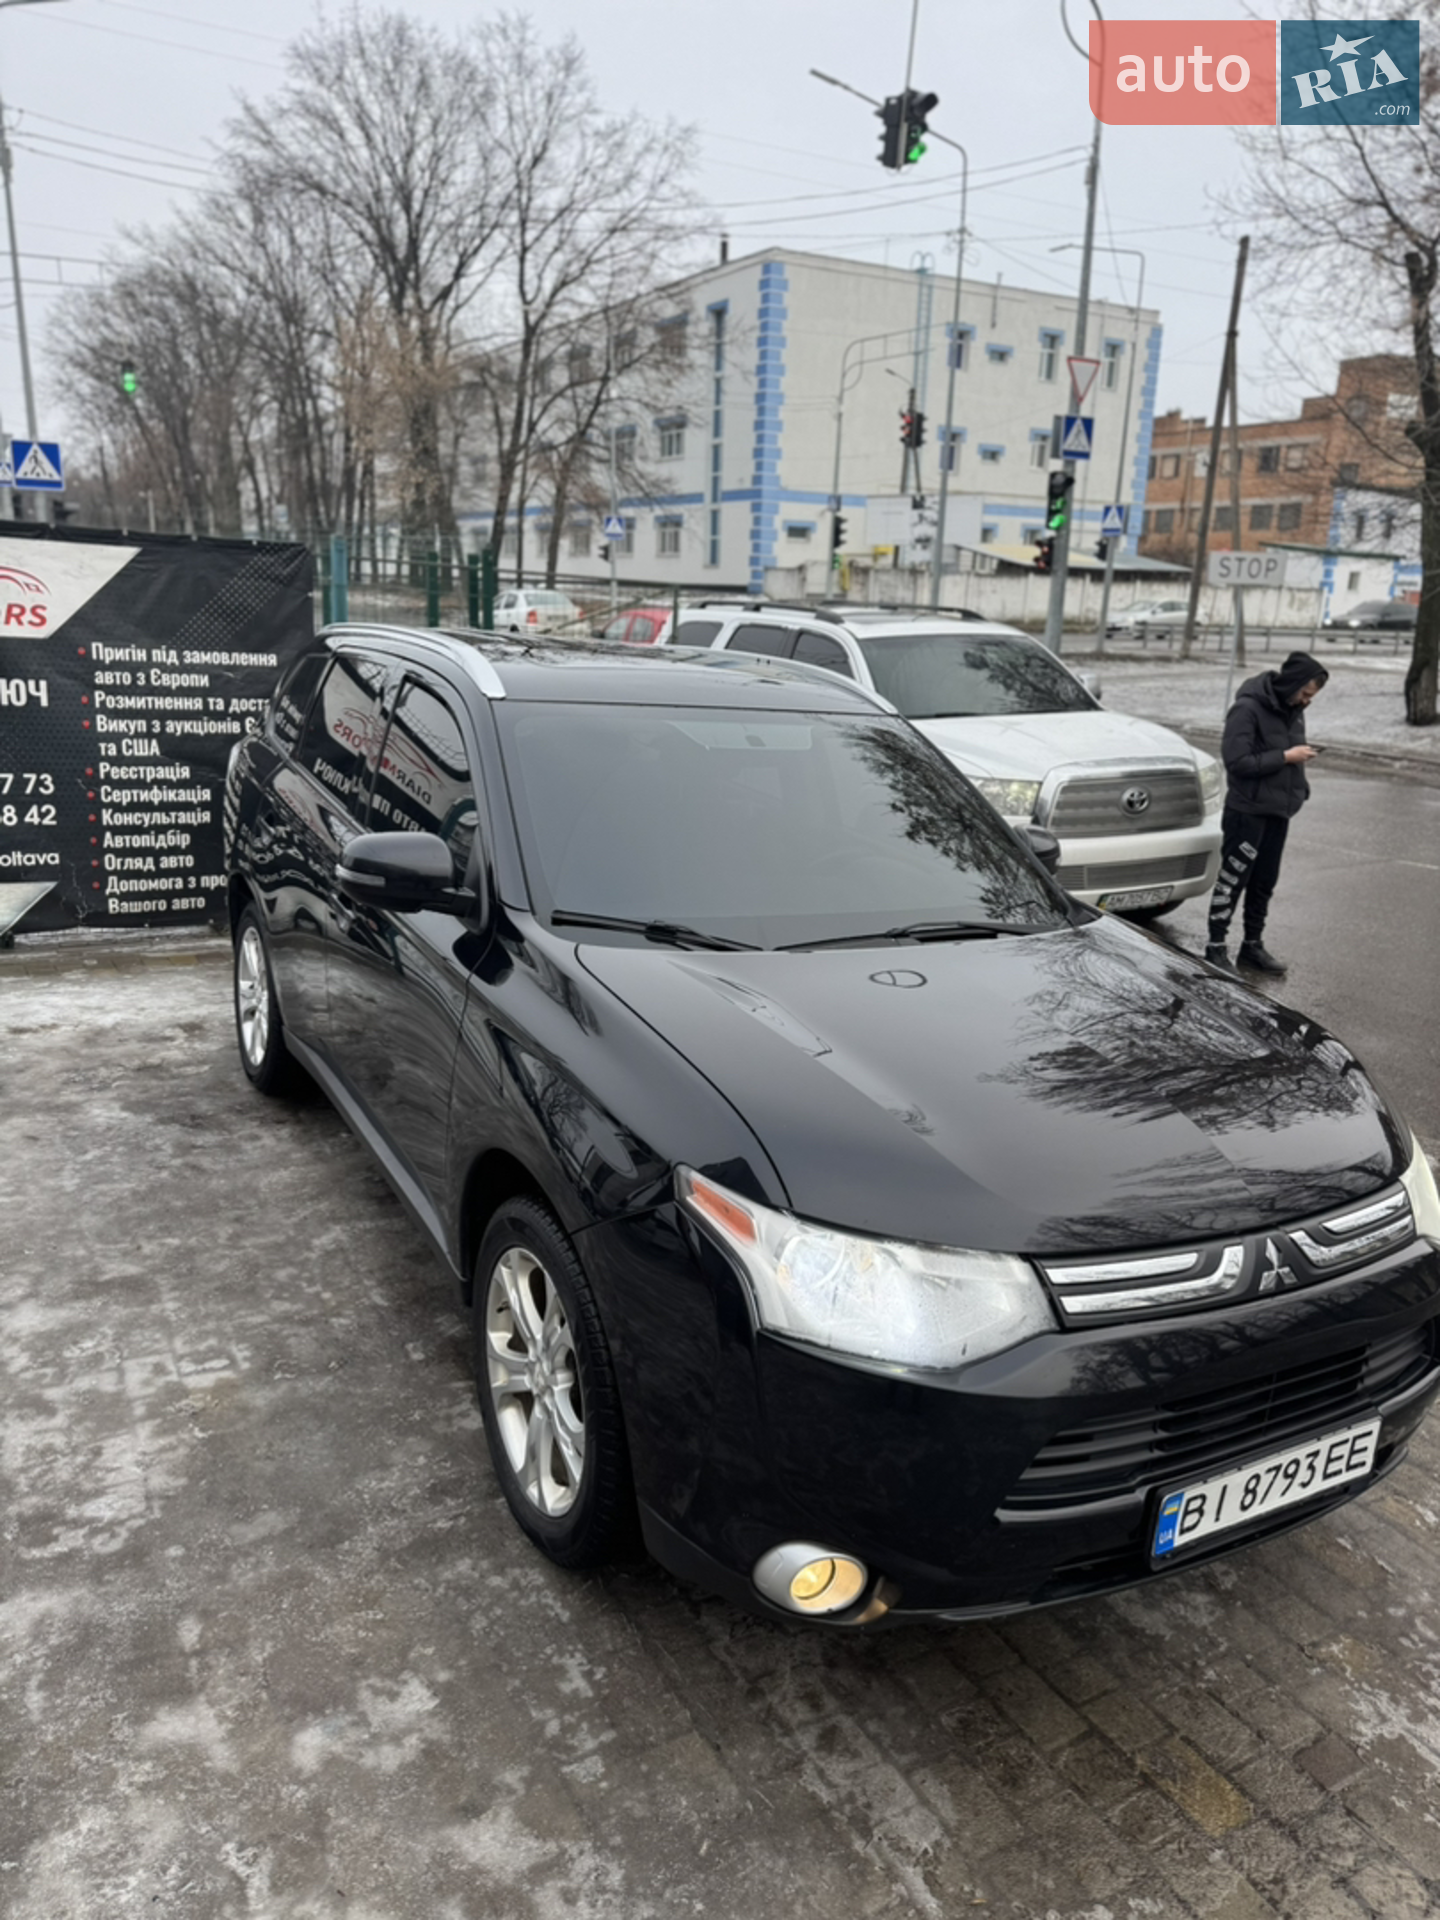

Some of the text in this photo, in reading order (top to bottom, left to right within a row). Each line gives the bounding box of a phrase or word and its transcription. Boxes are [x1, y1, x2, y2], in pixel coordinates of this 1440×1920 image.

[1218, 557, 1278, 579] STOP
[0, 603, 47, 628] RS
[91, 642, 277, 667] Пригін під замовлення
[94, 669, 209, 689] авто з Європи
[0, 676, 48, 707] ЮЧ
[95, 693, 203, 711] Розмитнення
[207, 698, 224, 711] та
[96, 715, 147, 736] Викуп
[152, 720, 161, 733] з
[165, 716, 240, 736] аукціонів
[99, 739, 160, 756] та США
[99, 763, 190, 781] Реєстрація
[22, 773, 55, 795] 73
[101, 784, 211, 804] Сертифікація
[0, 804, 57, 826] 8 42
[102, 808, 211, 826] Консультація
[103, 830, 190, 850] Автопідбір
[104, 854, 194, 872] Огляд авто
[105, 876, 184, 894] Допомога
[189, 878, 198, 889] з
[108, 896, 206, 915] Вашого авто
[1240, 1450, 1320, 1511] 8793
[1322, 1431, 1373, 1480] EE
